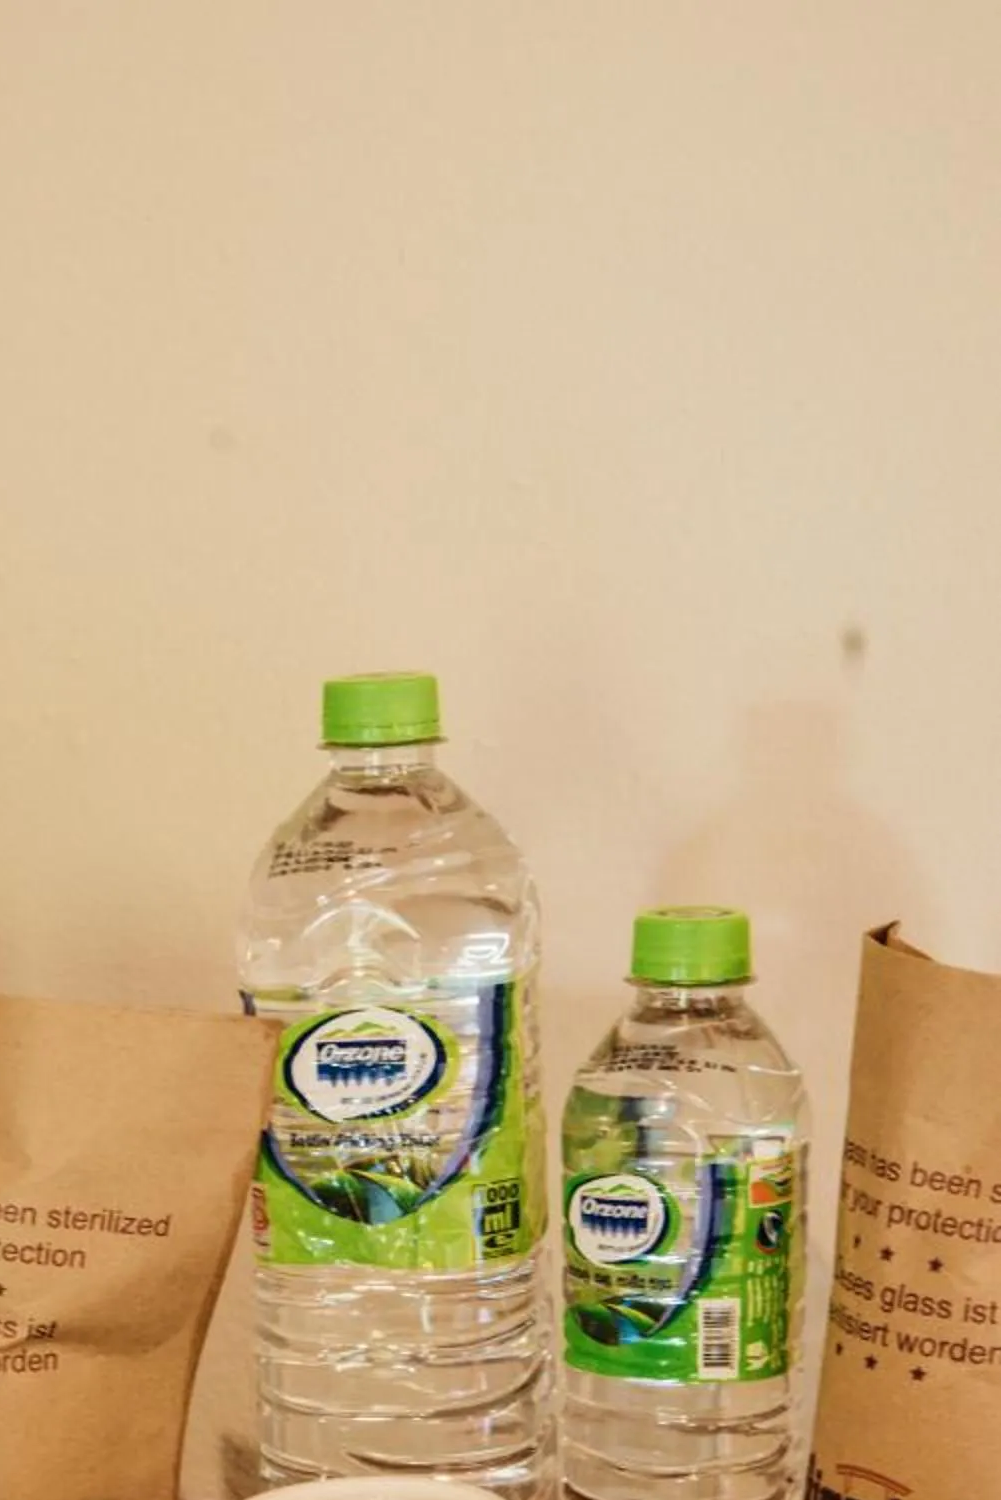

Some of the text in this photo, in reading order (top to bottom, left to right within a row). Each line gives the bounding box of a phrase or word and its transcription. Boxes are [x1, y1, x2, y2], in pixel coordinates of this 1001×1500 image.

[910, 1161, 982, 1199] been
[47, 1206, 172, 1238] sterilized
[887, 1203, 1001, 1244] protectio
[880, 1284, 952, 1319] glass
[963, 1297, 999, 1325] ist
[28, 1318, 58, 1339] ist
